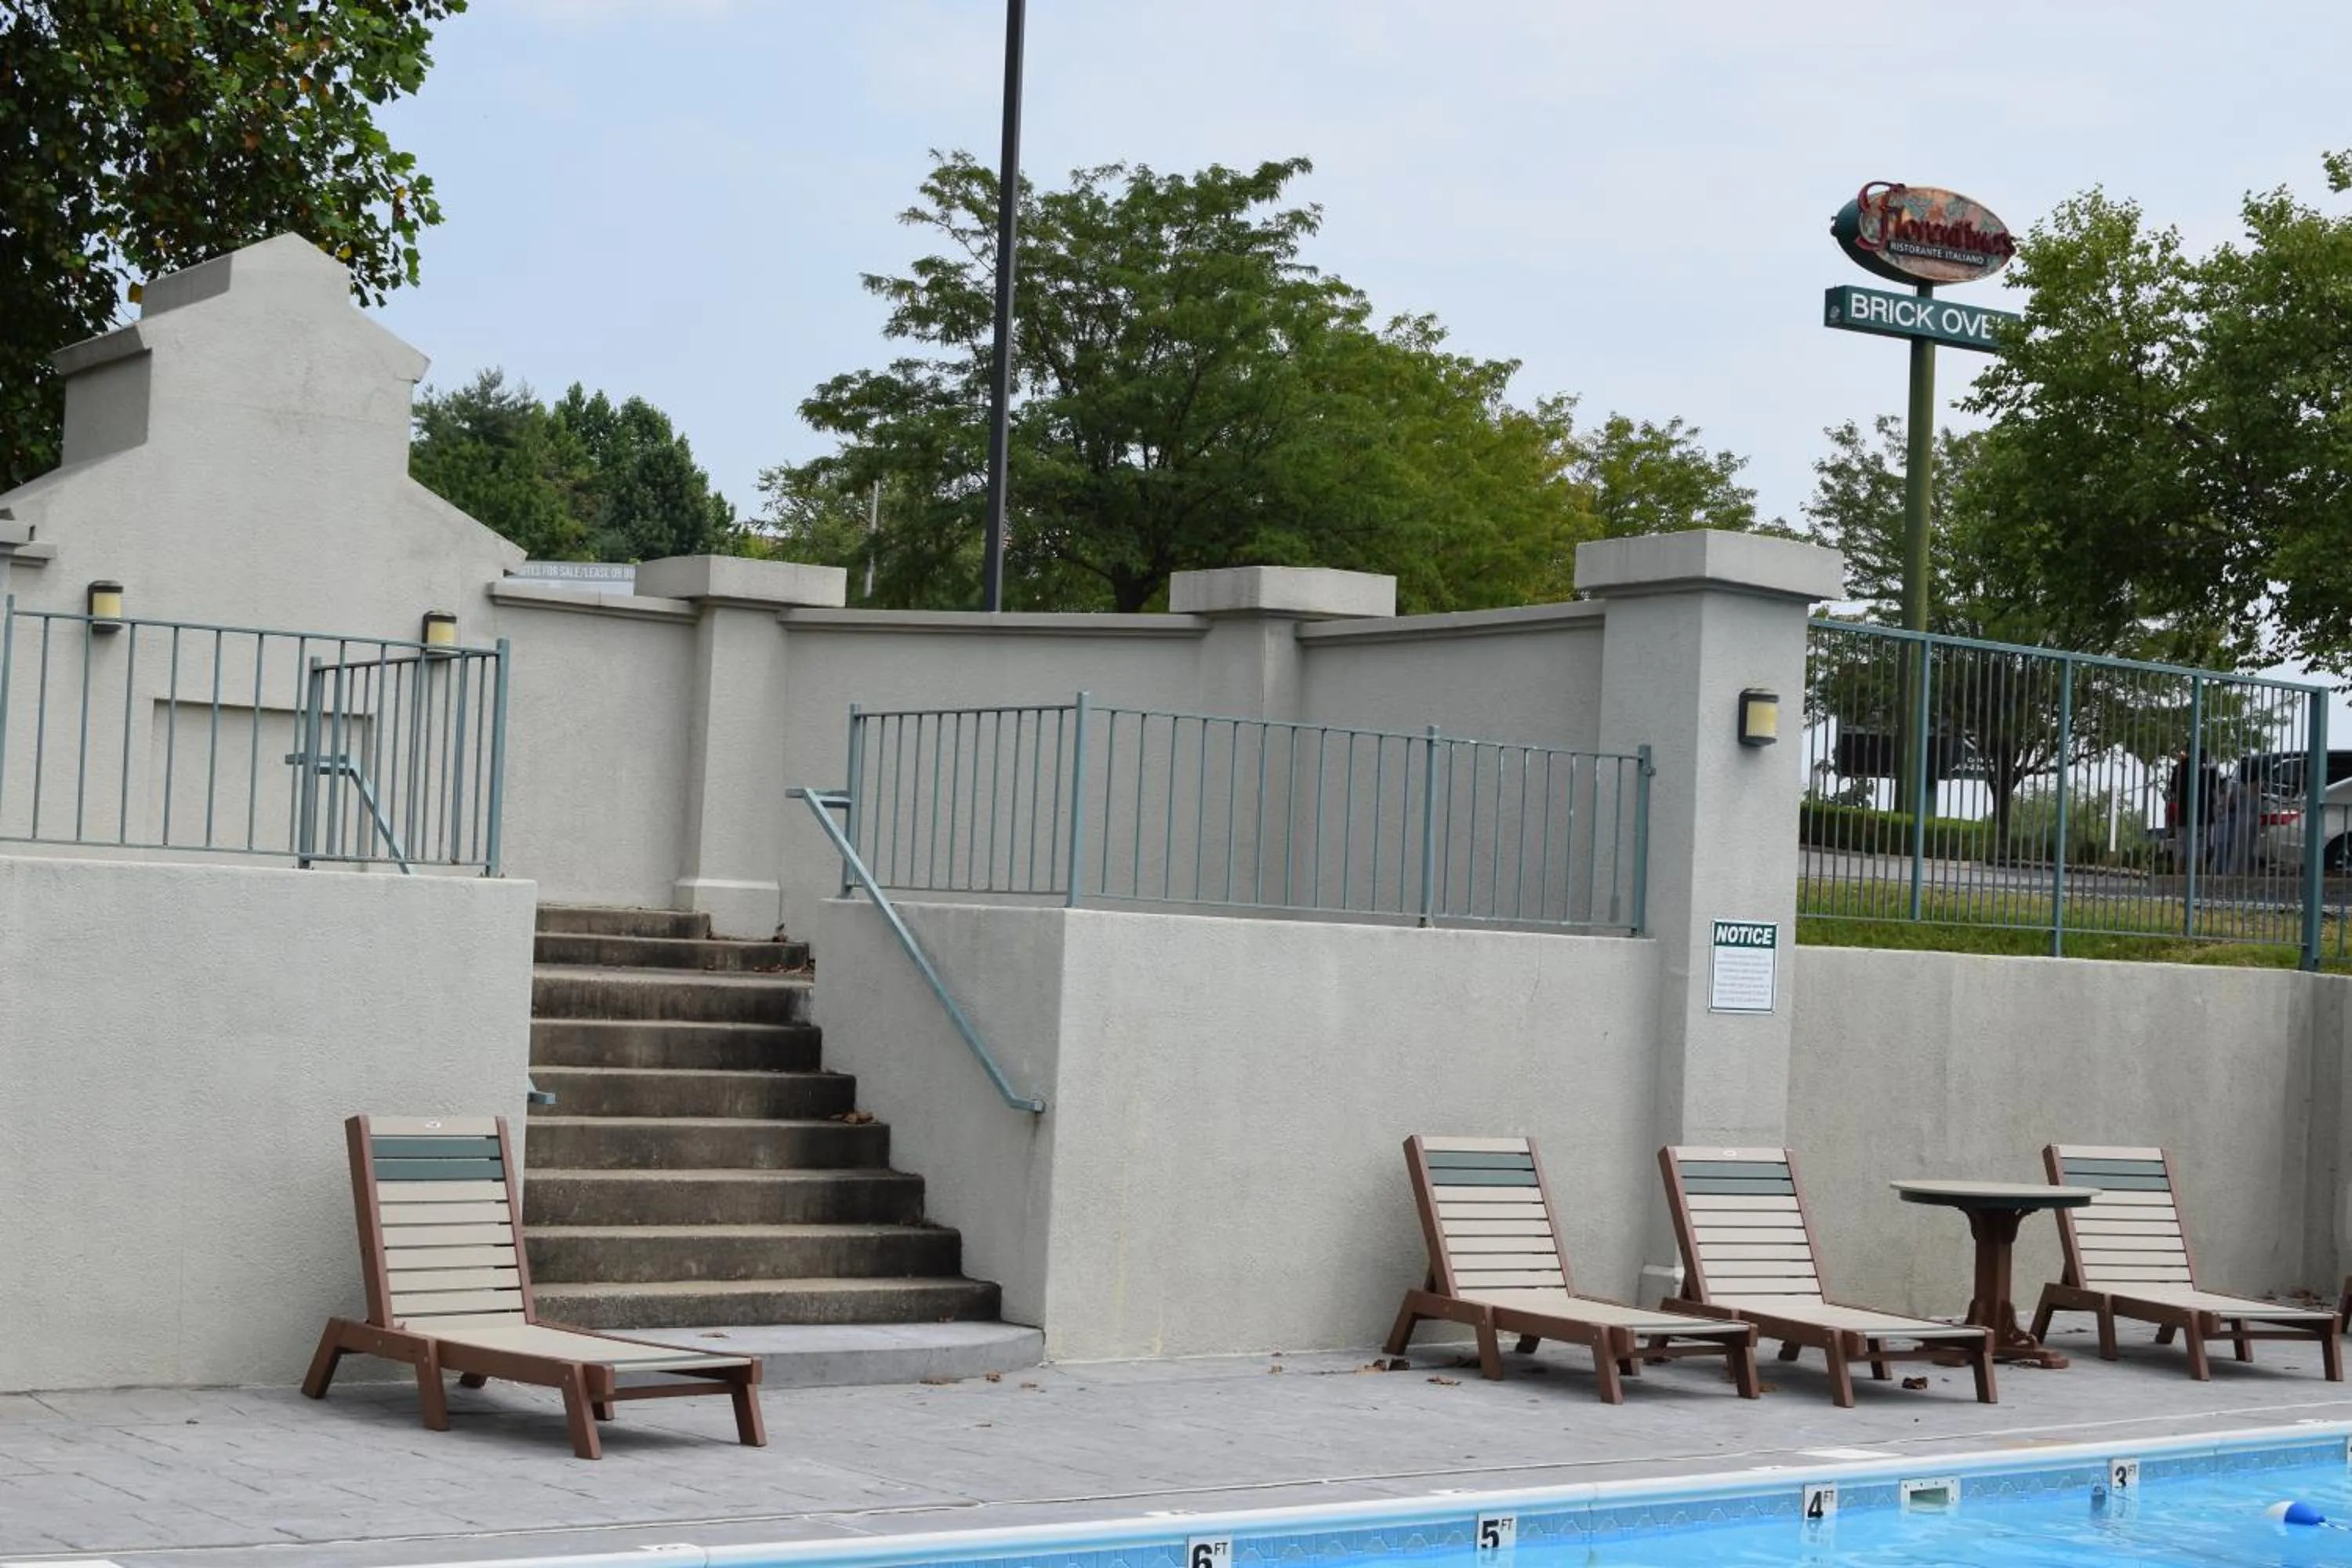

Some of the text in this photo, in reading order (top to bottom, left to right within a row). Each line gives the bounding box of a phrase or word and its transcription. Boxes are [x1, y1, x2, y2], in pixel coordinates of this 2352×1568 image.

[1890, 241, 1984, 265] RISTORANTE ITALIANO
[1851, 293, 2004, 339] BRICK OVE
[1715, 924, 1773, 946] NOTICE
[1808, 1491, 1824, 1518] 4
[1481, 1519, 1499, 1548] 5
[1192, 1543, 1213, 1568] 6
